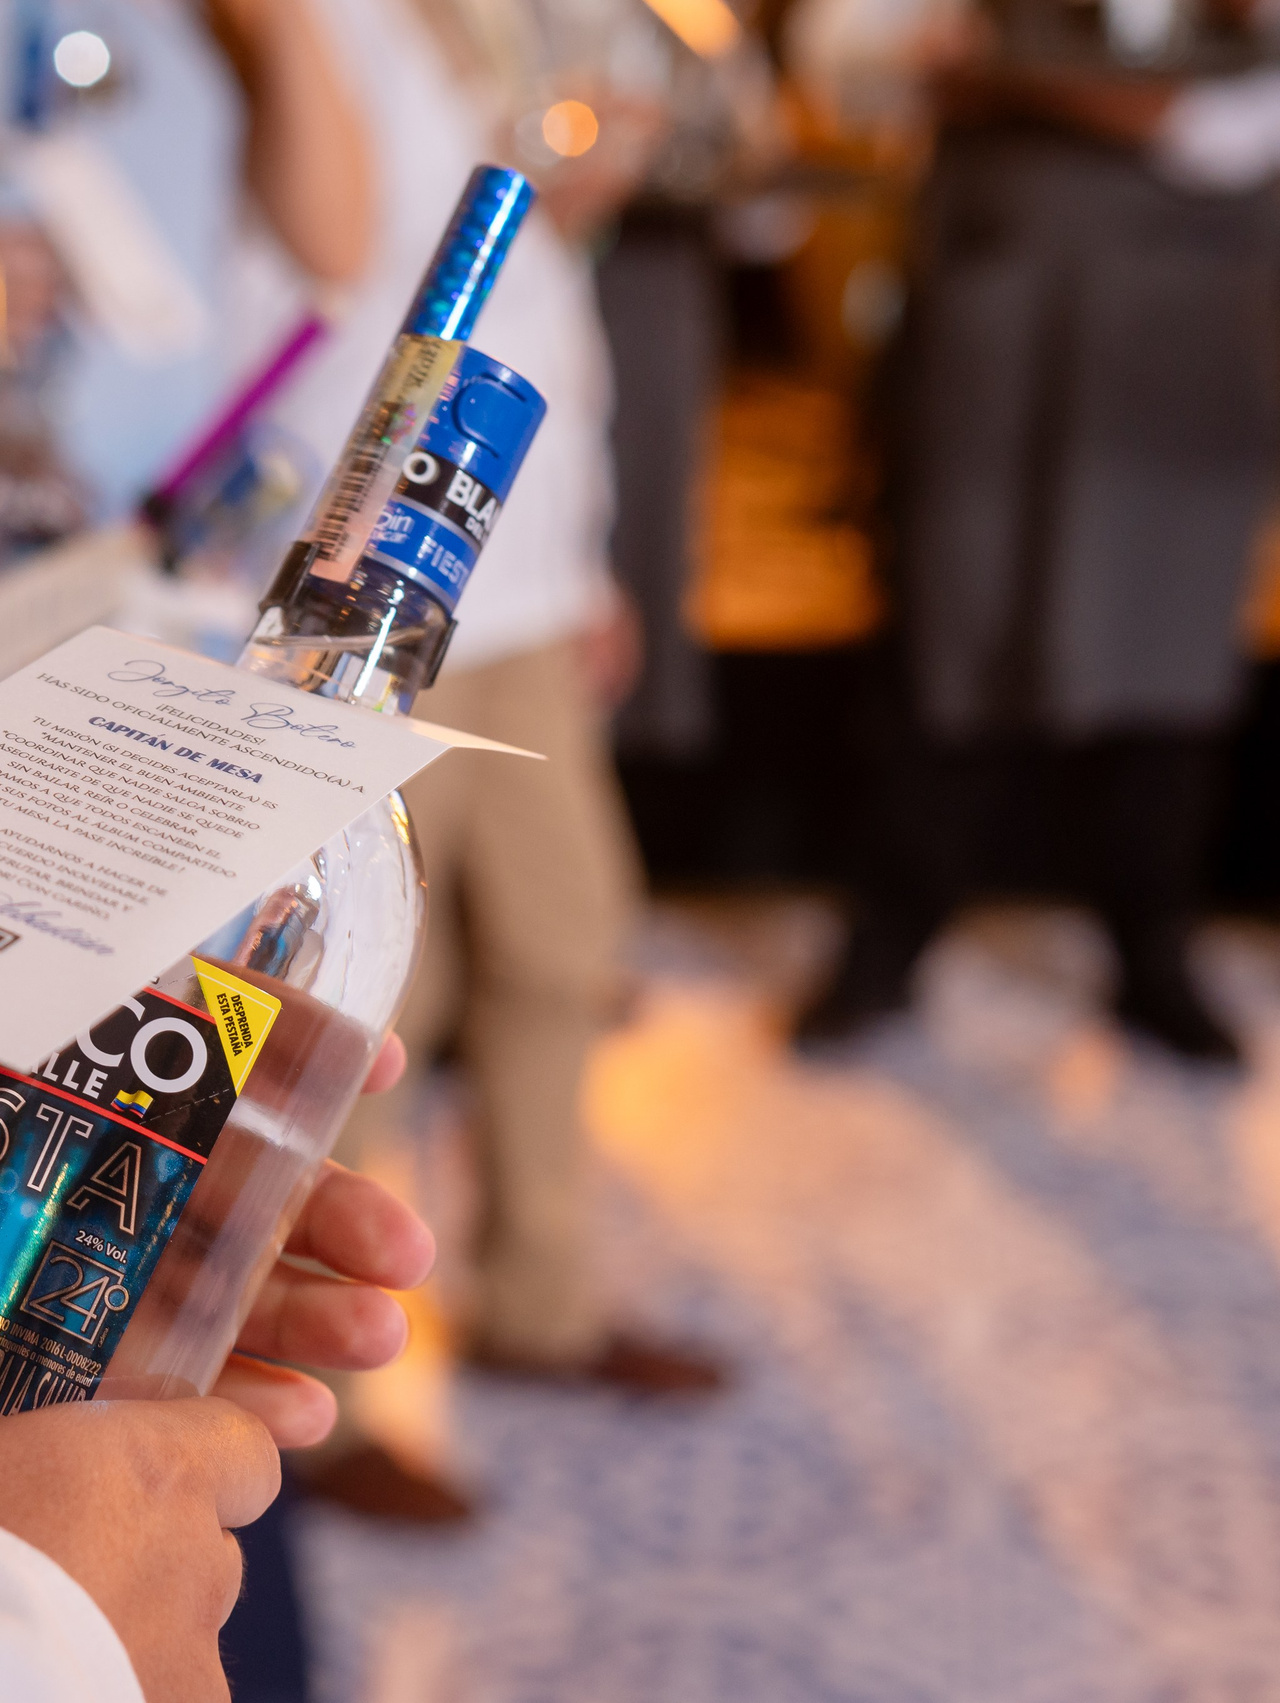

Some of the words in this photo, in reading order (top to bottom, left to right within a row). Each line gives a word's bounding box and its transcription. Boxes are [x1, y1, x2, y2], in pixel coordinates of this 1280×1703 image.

[446, 468, 503, 527] BLA
[416, 535, 471, 588] FIEST
[107, 659, 236, 706] Jorgito
[240, 702, 356, 749] Botero
[155, 703, 266, 746] ¡FELICIDADES!
[36, 672, 71, 689] HAS
[69, 686, 111, 703] SIDO
[111, 701, 230, 746] OFICIALMENTE
[228, 743, 351, 788] ASCENDIDO(A)
[351, 785, 364, 794] A
[88, 716, 174, 751] CAPITÁN
[173, 746, 207, 764] DE
[205, 757, 263, 784] MESA
[32, 715, 52, 727] TU
[50, 724, 102, 746] MISIÓN
[102, 742, 121, 753] (SI
[119, 749, 179, 774] DECIDES
[176, 772, 261, 804] ACEPTARLA)
[261, 800, 279, 810] ES
[117, 762, 134, 773] EL
[135, 768, 175, 786] BUEN
[173, 784, 246, 812] AMBIENTE
[1, 786, 28, 799] SUS
[26, 795, 72, 817] FOTOS
[69, 814, 89, 825] AL
[6, 760, 33, 774] SIN
[115, 802, 129, 810] O
[129, 807, 198, 837] CELEBRAR
[38, 788, 50, 796] A
[52, 792, 84, 807] QUE
[84, 803, 132, 825] TODOS
[131, 822, 205, 853] ESCANEEN
[205, 849, 221, 860] EL
[80, 775, 102, 786] DE
[101, 783, 133, 798] QUE
[131, 794, 178, 815] NADIE
[176, 811, 195, 821] SE
[195, 818, 245, 839] QUEDE
[88, 764, 119, 779] QUE
[117, 775, 164, 796] NADIE
[162, 792, 206, 813] SALGA
[208, 808, 261, 830] SOBRIO
[12, 805, 50, 824] MESA
[51, 819, 70, 832] LA
[71, 827, 106, 844] PASE
[215, 992, 231, 1016] ESTA
[230, 993, 254, 1049] DESPRENDA
[75, 997, 208, 1093] CO
[222, 1014, 245, 1057] PESTAÑA
[31, 1051, 107, 1100] LLE
[74, 1229, 106, 1251] 24%
[105, 1241, 129, 1265] Vol.
[8, 1322, 42, 1346] INVIMA
[34, 1354, 66, 1375] menores
[64, 1365, 77, 1380] de
[73, 1369, 95, 1388] edad
